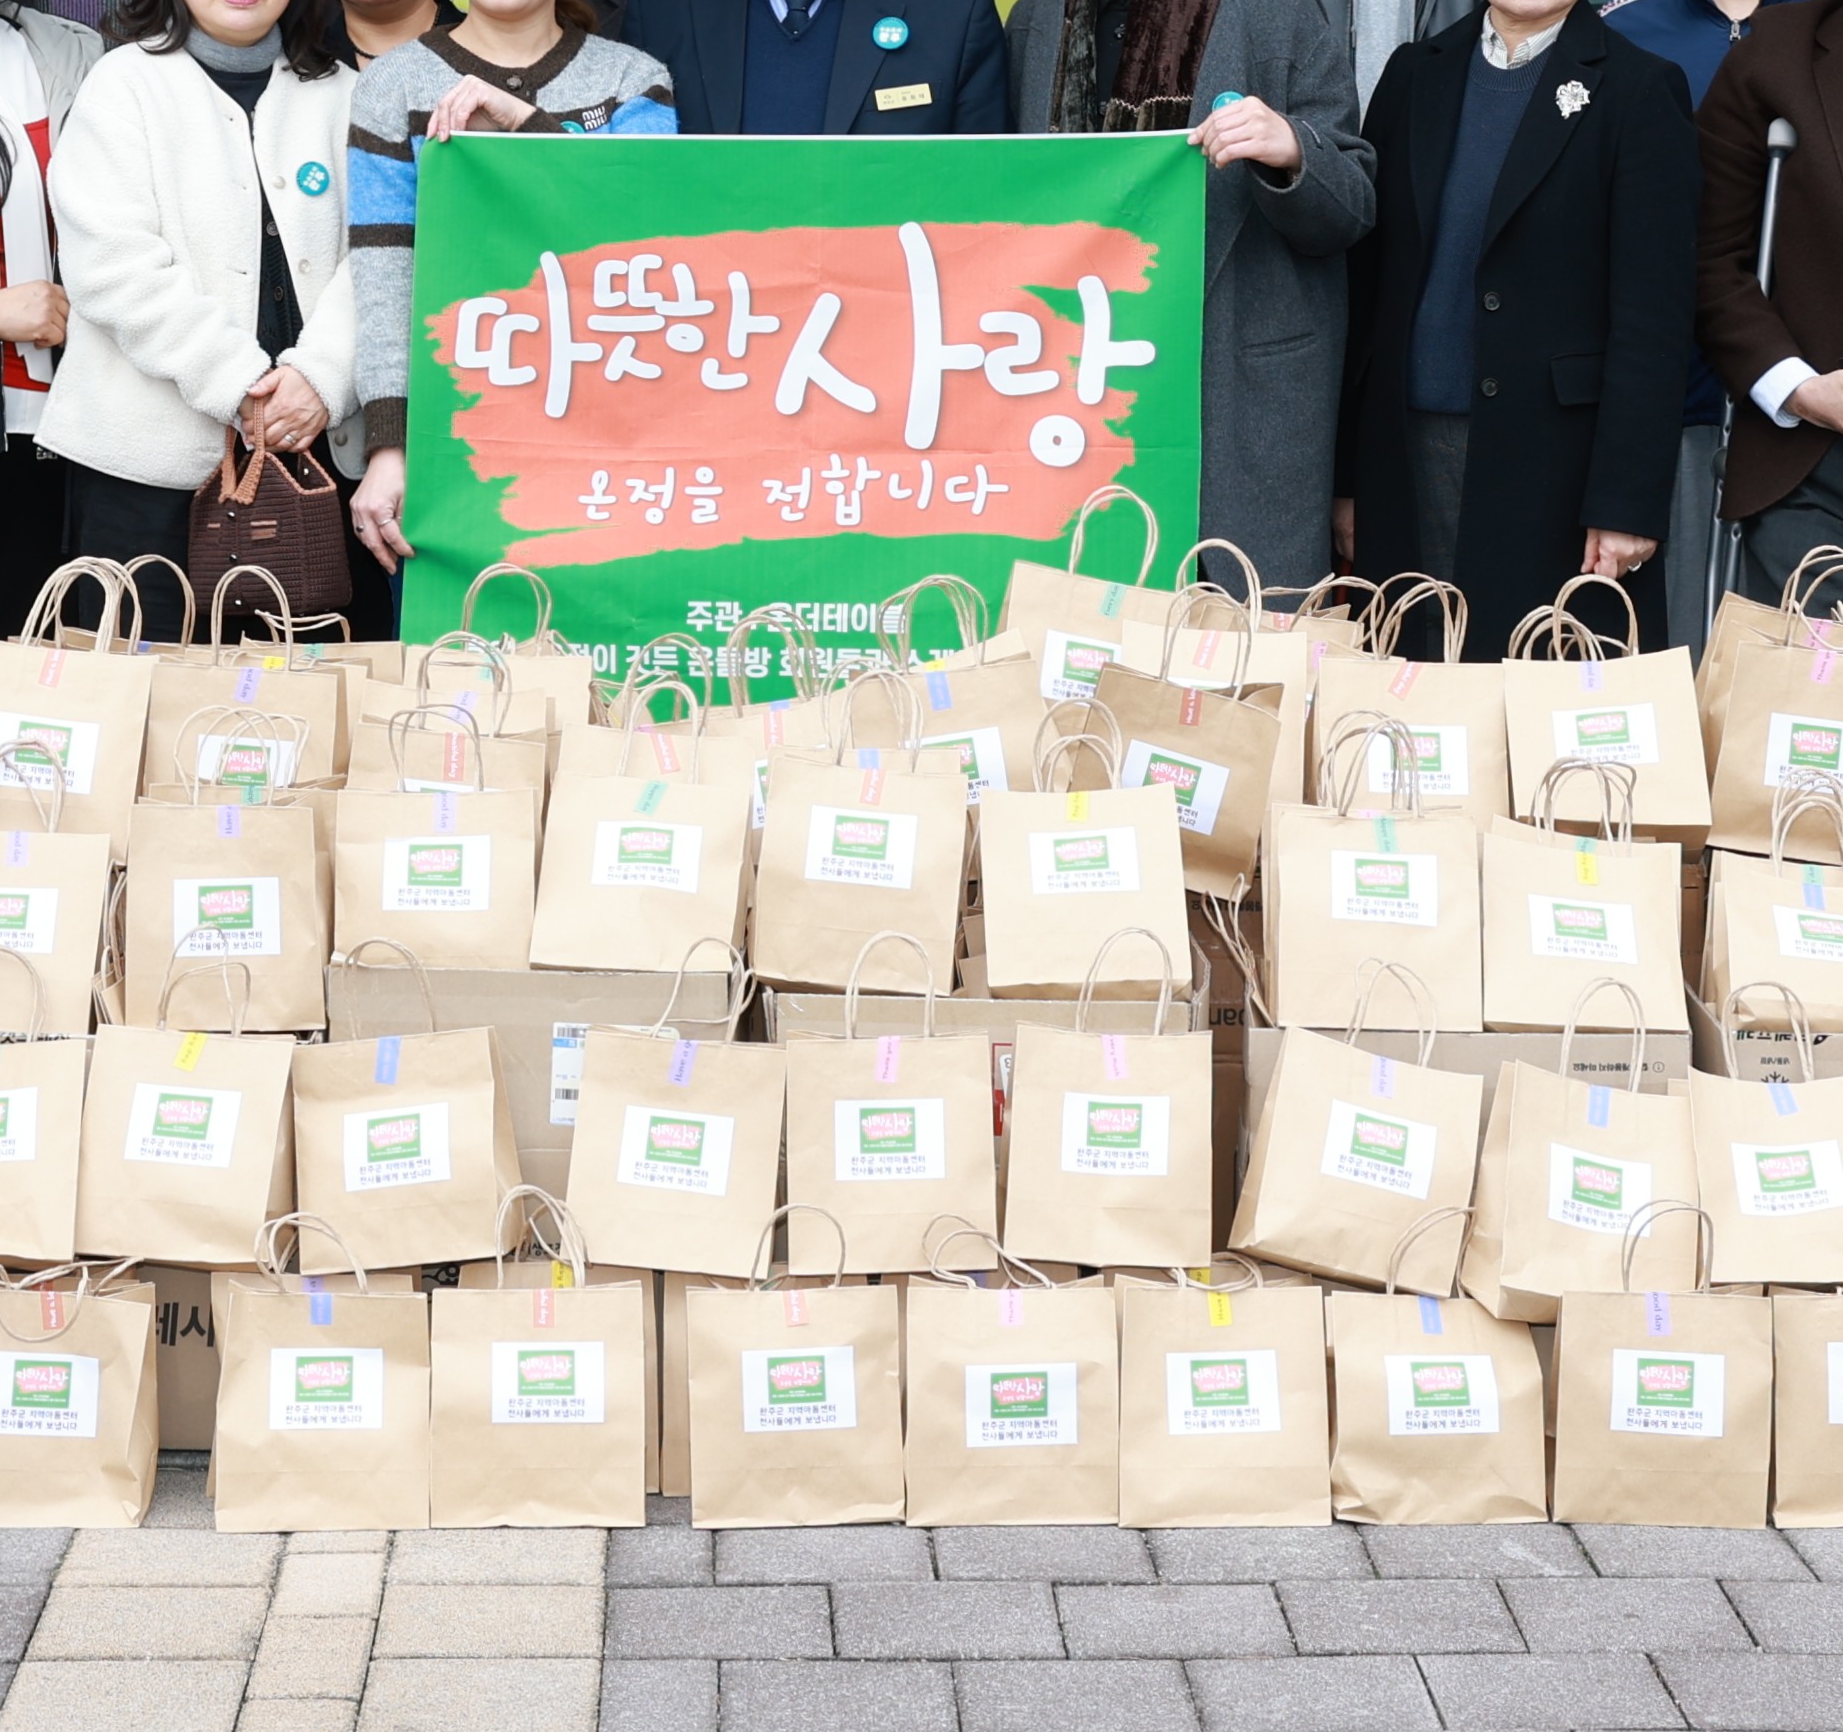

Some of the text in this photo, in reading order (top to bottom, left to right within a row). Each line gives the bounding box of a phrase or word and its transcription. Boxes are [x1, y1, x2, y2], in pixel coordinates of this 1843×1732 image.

[454, 221, 1157, 468] 따뜻한 사랑
[577, 452, 1010, 527] 온정을 전합니다
[686, 600, 744, 632] 주관
